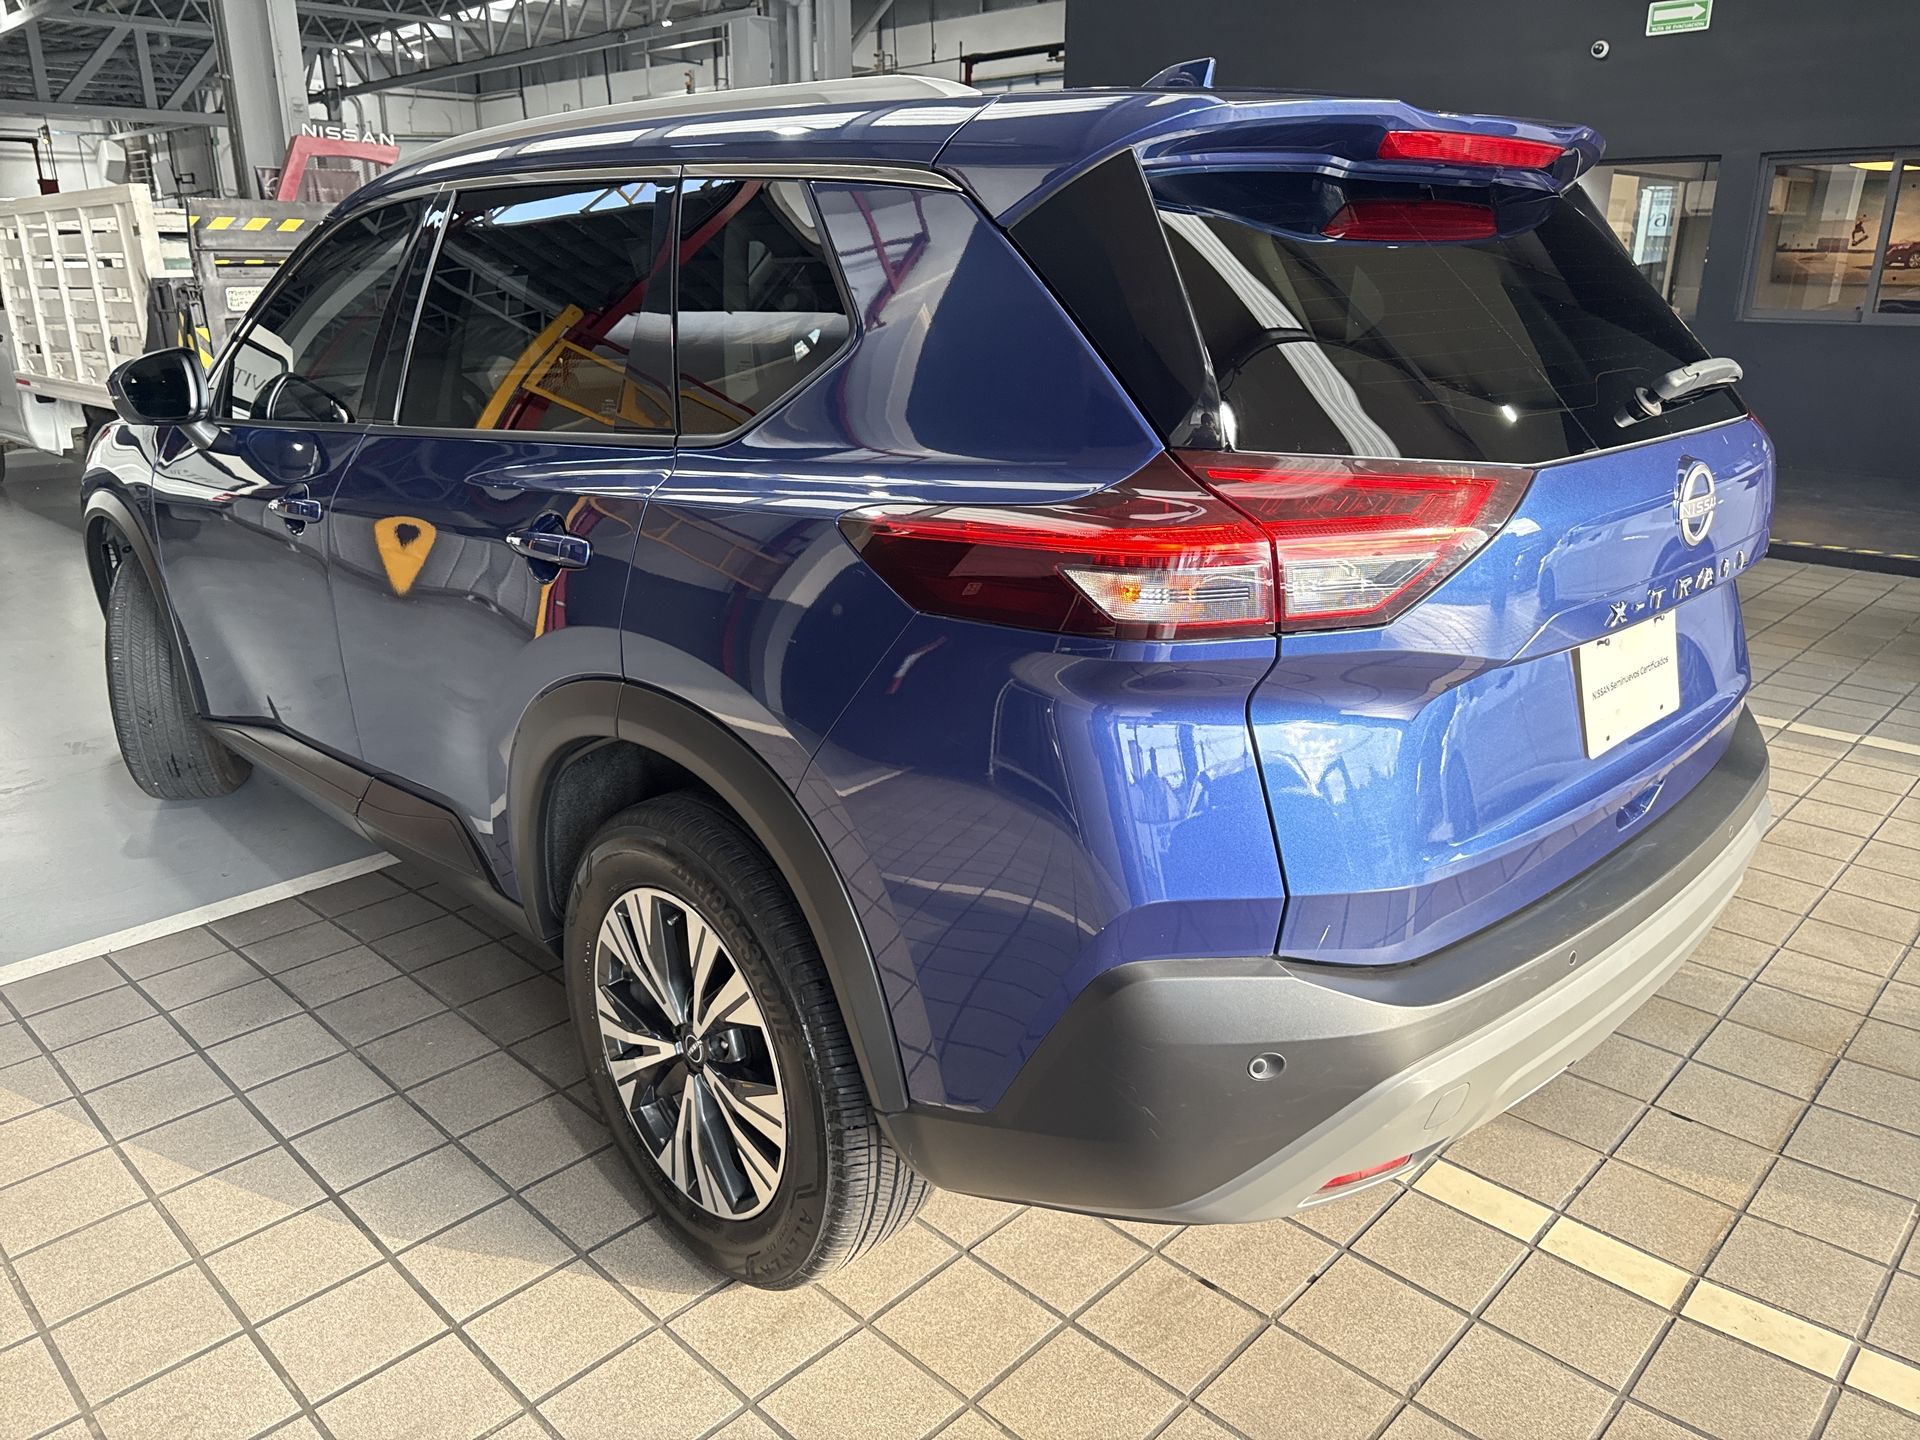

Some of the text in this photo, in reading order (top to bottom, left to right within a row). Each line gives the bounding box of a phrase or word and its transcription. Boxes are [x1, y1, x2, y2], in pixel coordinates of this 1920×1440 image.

[301, 122, 395, 147] NISSAN
[1680, 496, 1716, 519] NISSA
[1603, 550, 1749, 629] X-TRAIL
[1592, 655, 1669, 701] NISSAN Seminuevos Certificados
